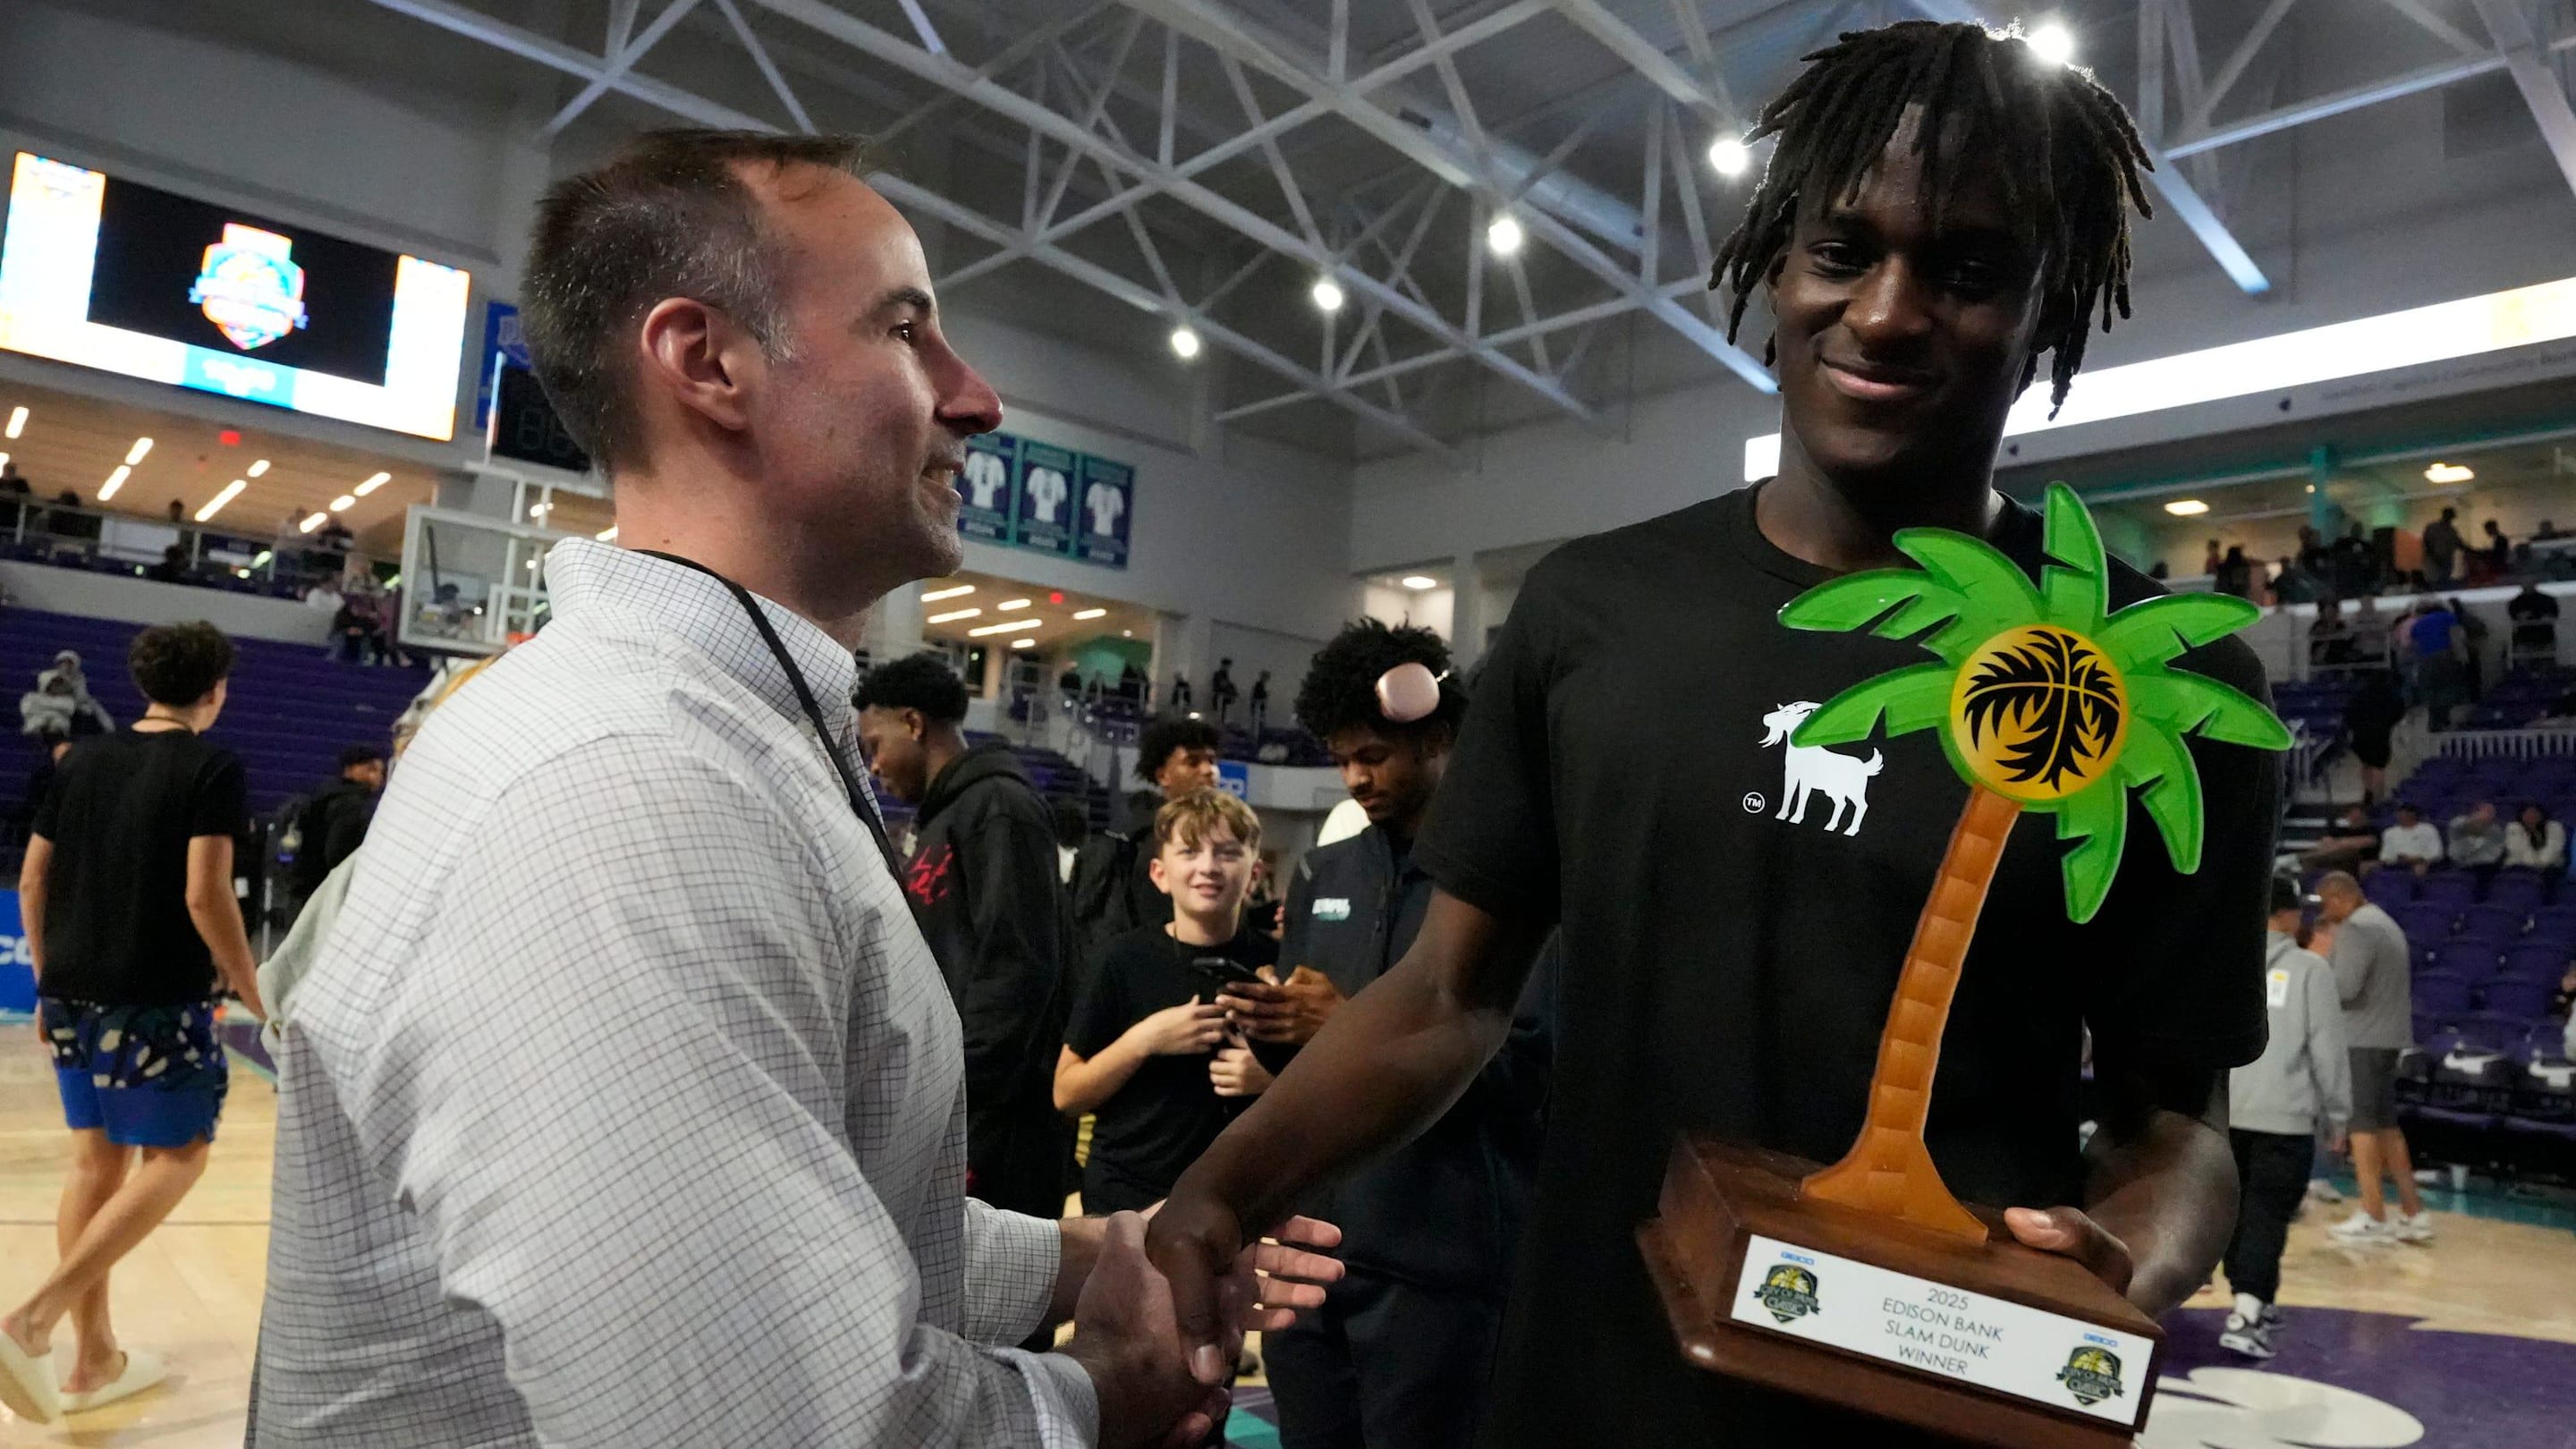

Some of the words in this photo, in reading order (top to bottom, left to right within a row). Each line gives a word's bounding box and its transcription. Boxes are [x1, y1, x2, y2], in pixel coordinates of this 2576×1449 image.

[1746, 797, 1762, 809] TM
[1928, 1288, 1969, 1310] 2025
[1882, 1298, 1950, 1326] EDISON
[1954, 1318, 2004, 1342] BANK
[1885, 1320, 1934, 1343] SLAM
[1939, 1335, 1989, 1360] DUNK
[1898, 1344, 1968, 1376] WINNER
